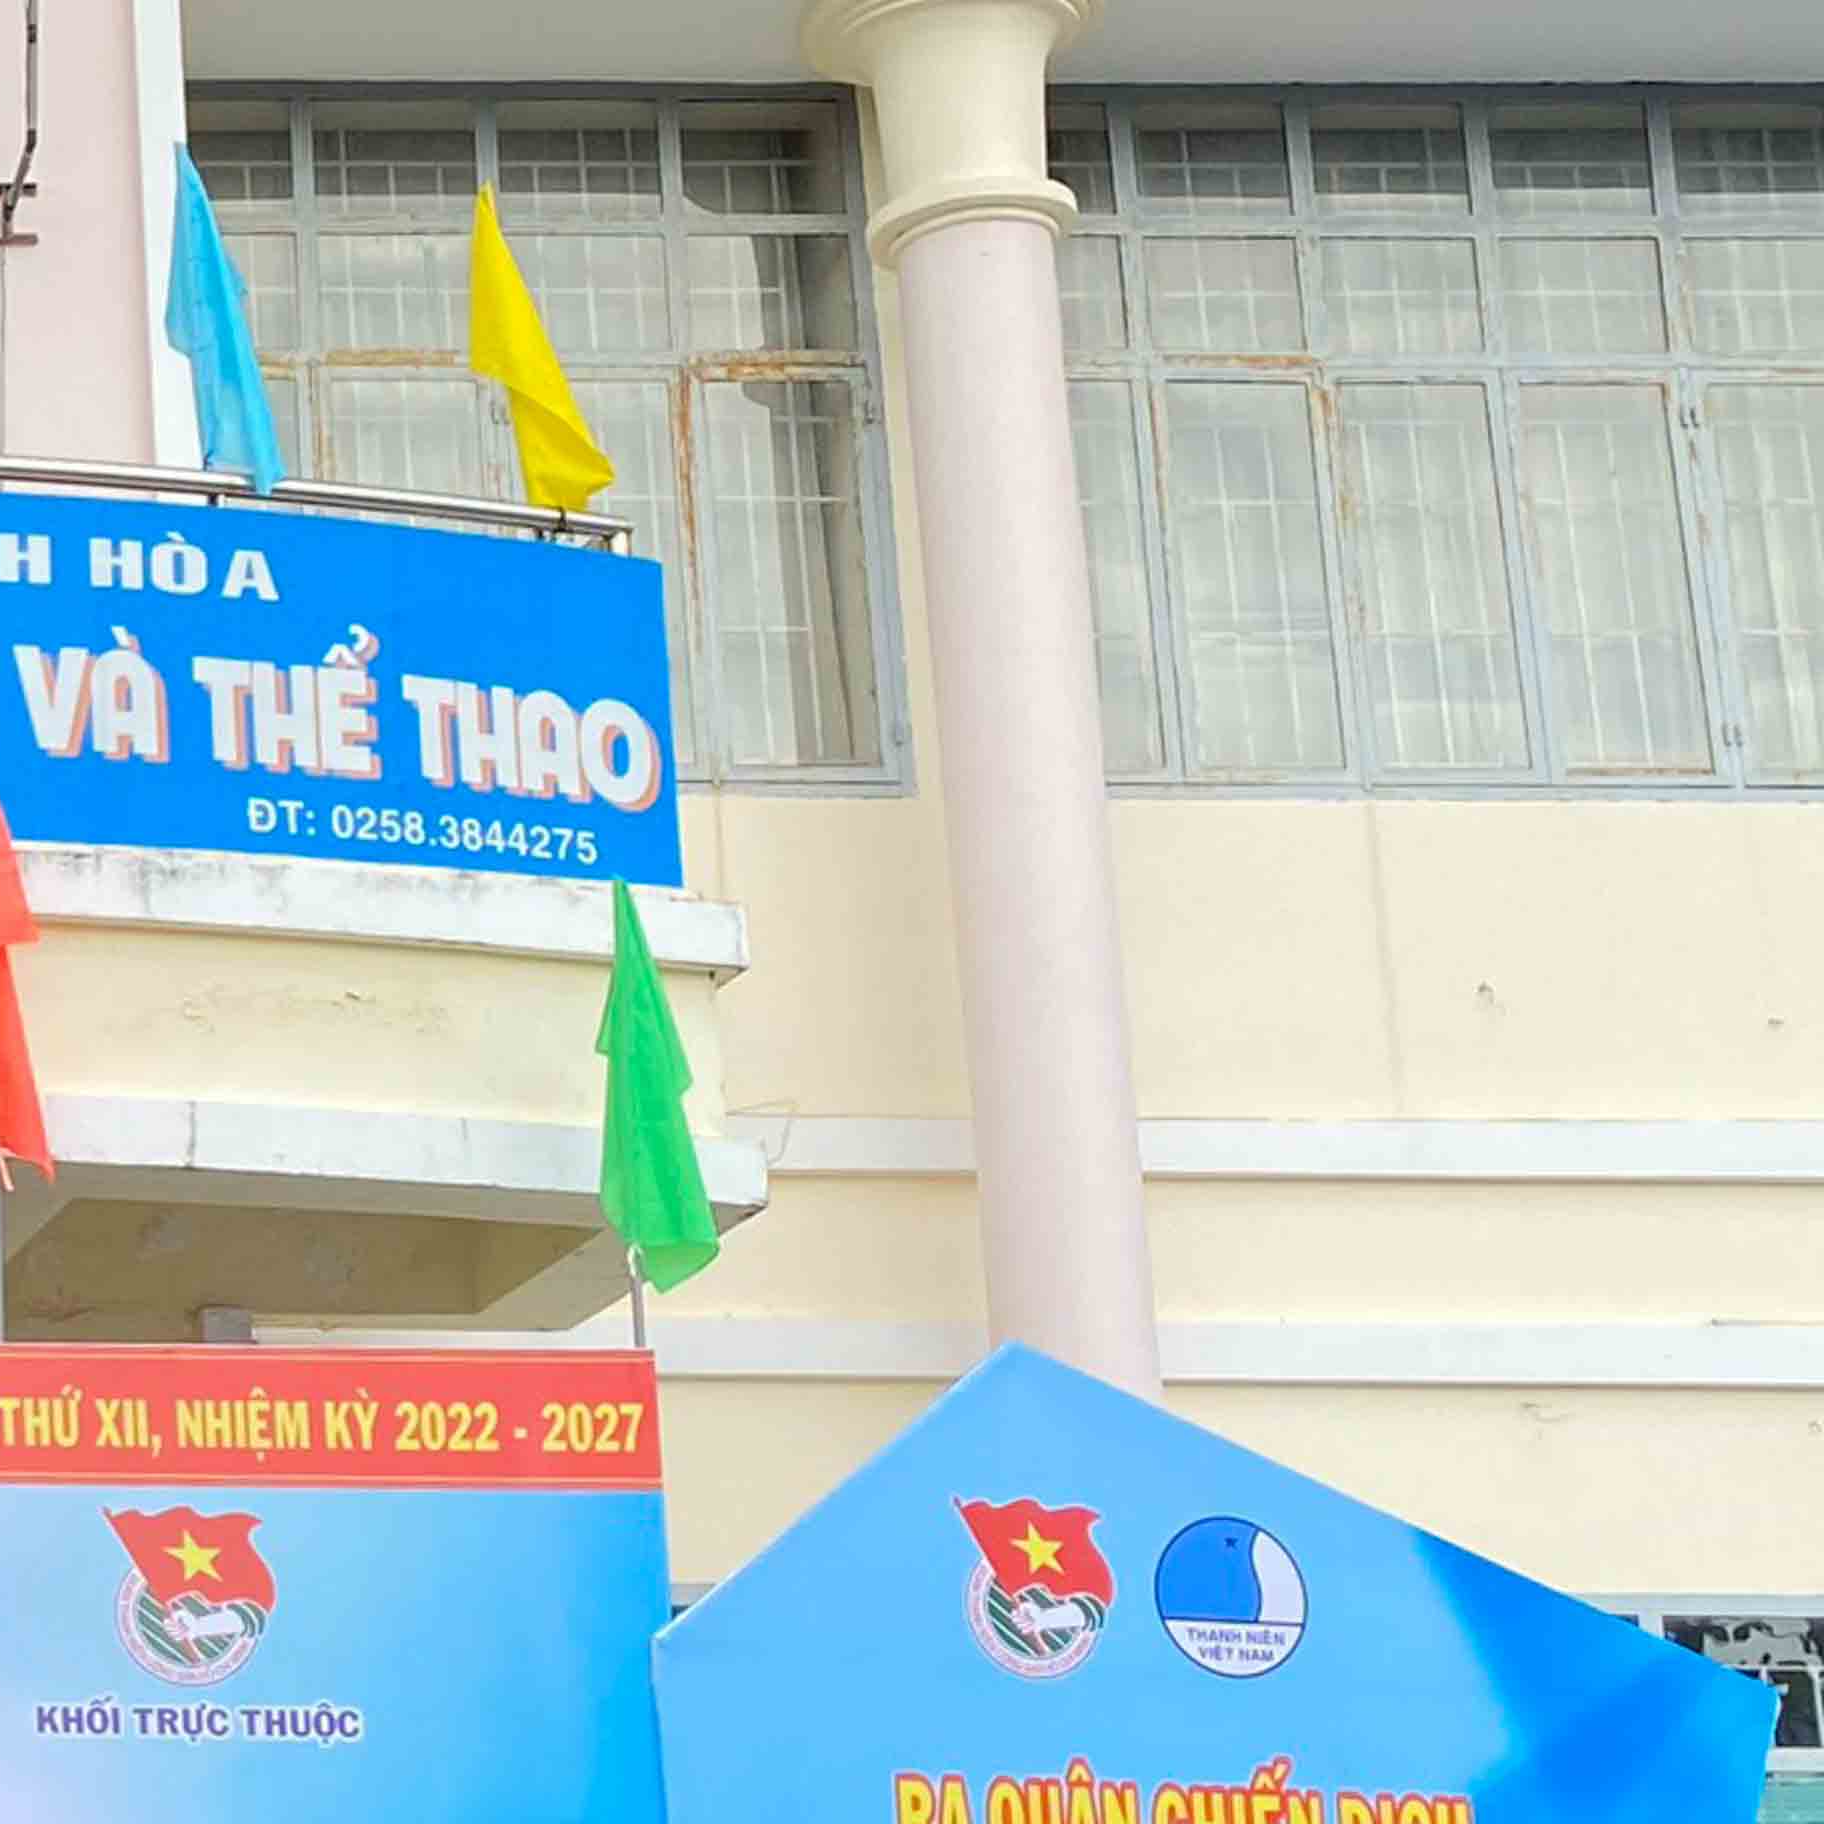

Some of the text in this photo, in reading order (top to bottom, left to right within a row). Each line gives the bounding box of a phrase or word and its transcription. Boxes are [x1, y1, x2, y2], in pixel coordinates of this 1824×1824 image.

[89, 532, 279, 601] HÒA
[13, 625, 169, 763] VÀ
[192, 624, 382, 780] THỂ
[402, 674, 662, 811] THAO
[248, 797, 598, 864] ĐT: 0258.3844275
[95, 1401, 162, 1457] XII,
[176, 1386, 311, 1461] NHIỆM
[324, 1388, 380, 1450] KỲ
[394, 1402, 500, 1452] 2022
[542, 1402, 643, 1453] 2027
[1188, 1628, 1286, 1646] THANH NIÊN
[1239, 1648, 1274, 1662] NAM
[36, 1696, 360, 1744] KHỐI TRỰC THUỘC
